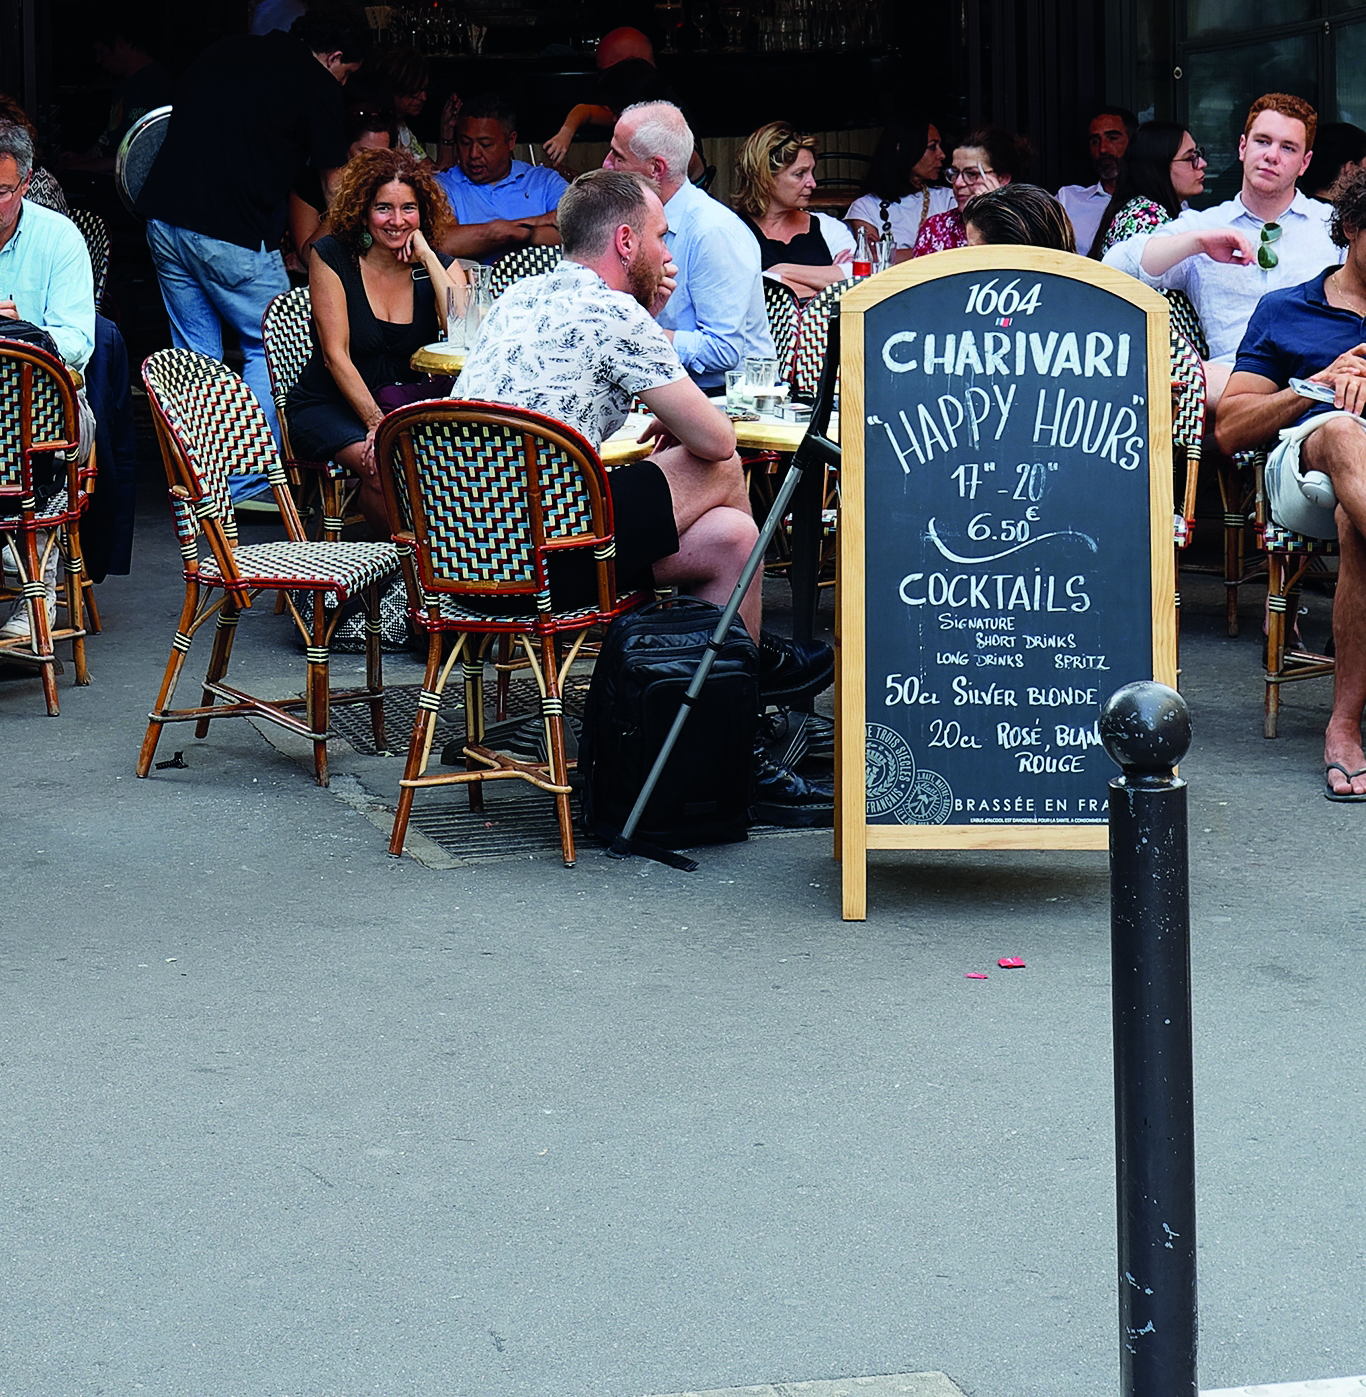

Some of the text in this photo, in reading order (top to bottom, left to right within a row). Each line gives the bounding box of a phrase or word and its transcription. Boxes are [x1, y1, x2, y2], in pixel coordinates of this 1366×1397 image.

[965, 278, 1042, 315] 1664
[882, 330, 1130, 377] CHARIVARI
[975, 632, 1016, 648] SHORT
[937, 652, 969, 665] LONG
[1027, 687, 1097, 706] BLONDE
[875, 727, 901, 748] TROIS
[1015, 752, 1085, 773] ROUGE
[955, 796, 1034, 811] BRASSÉE
[1046, 799, 1067, 811] EN
